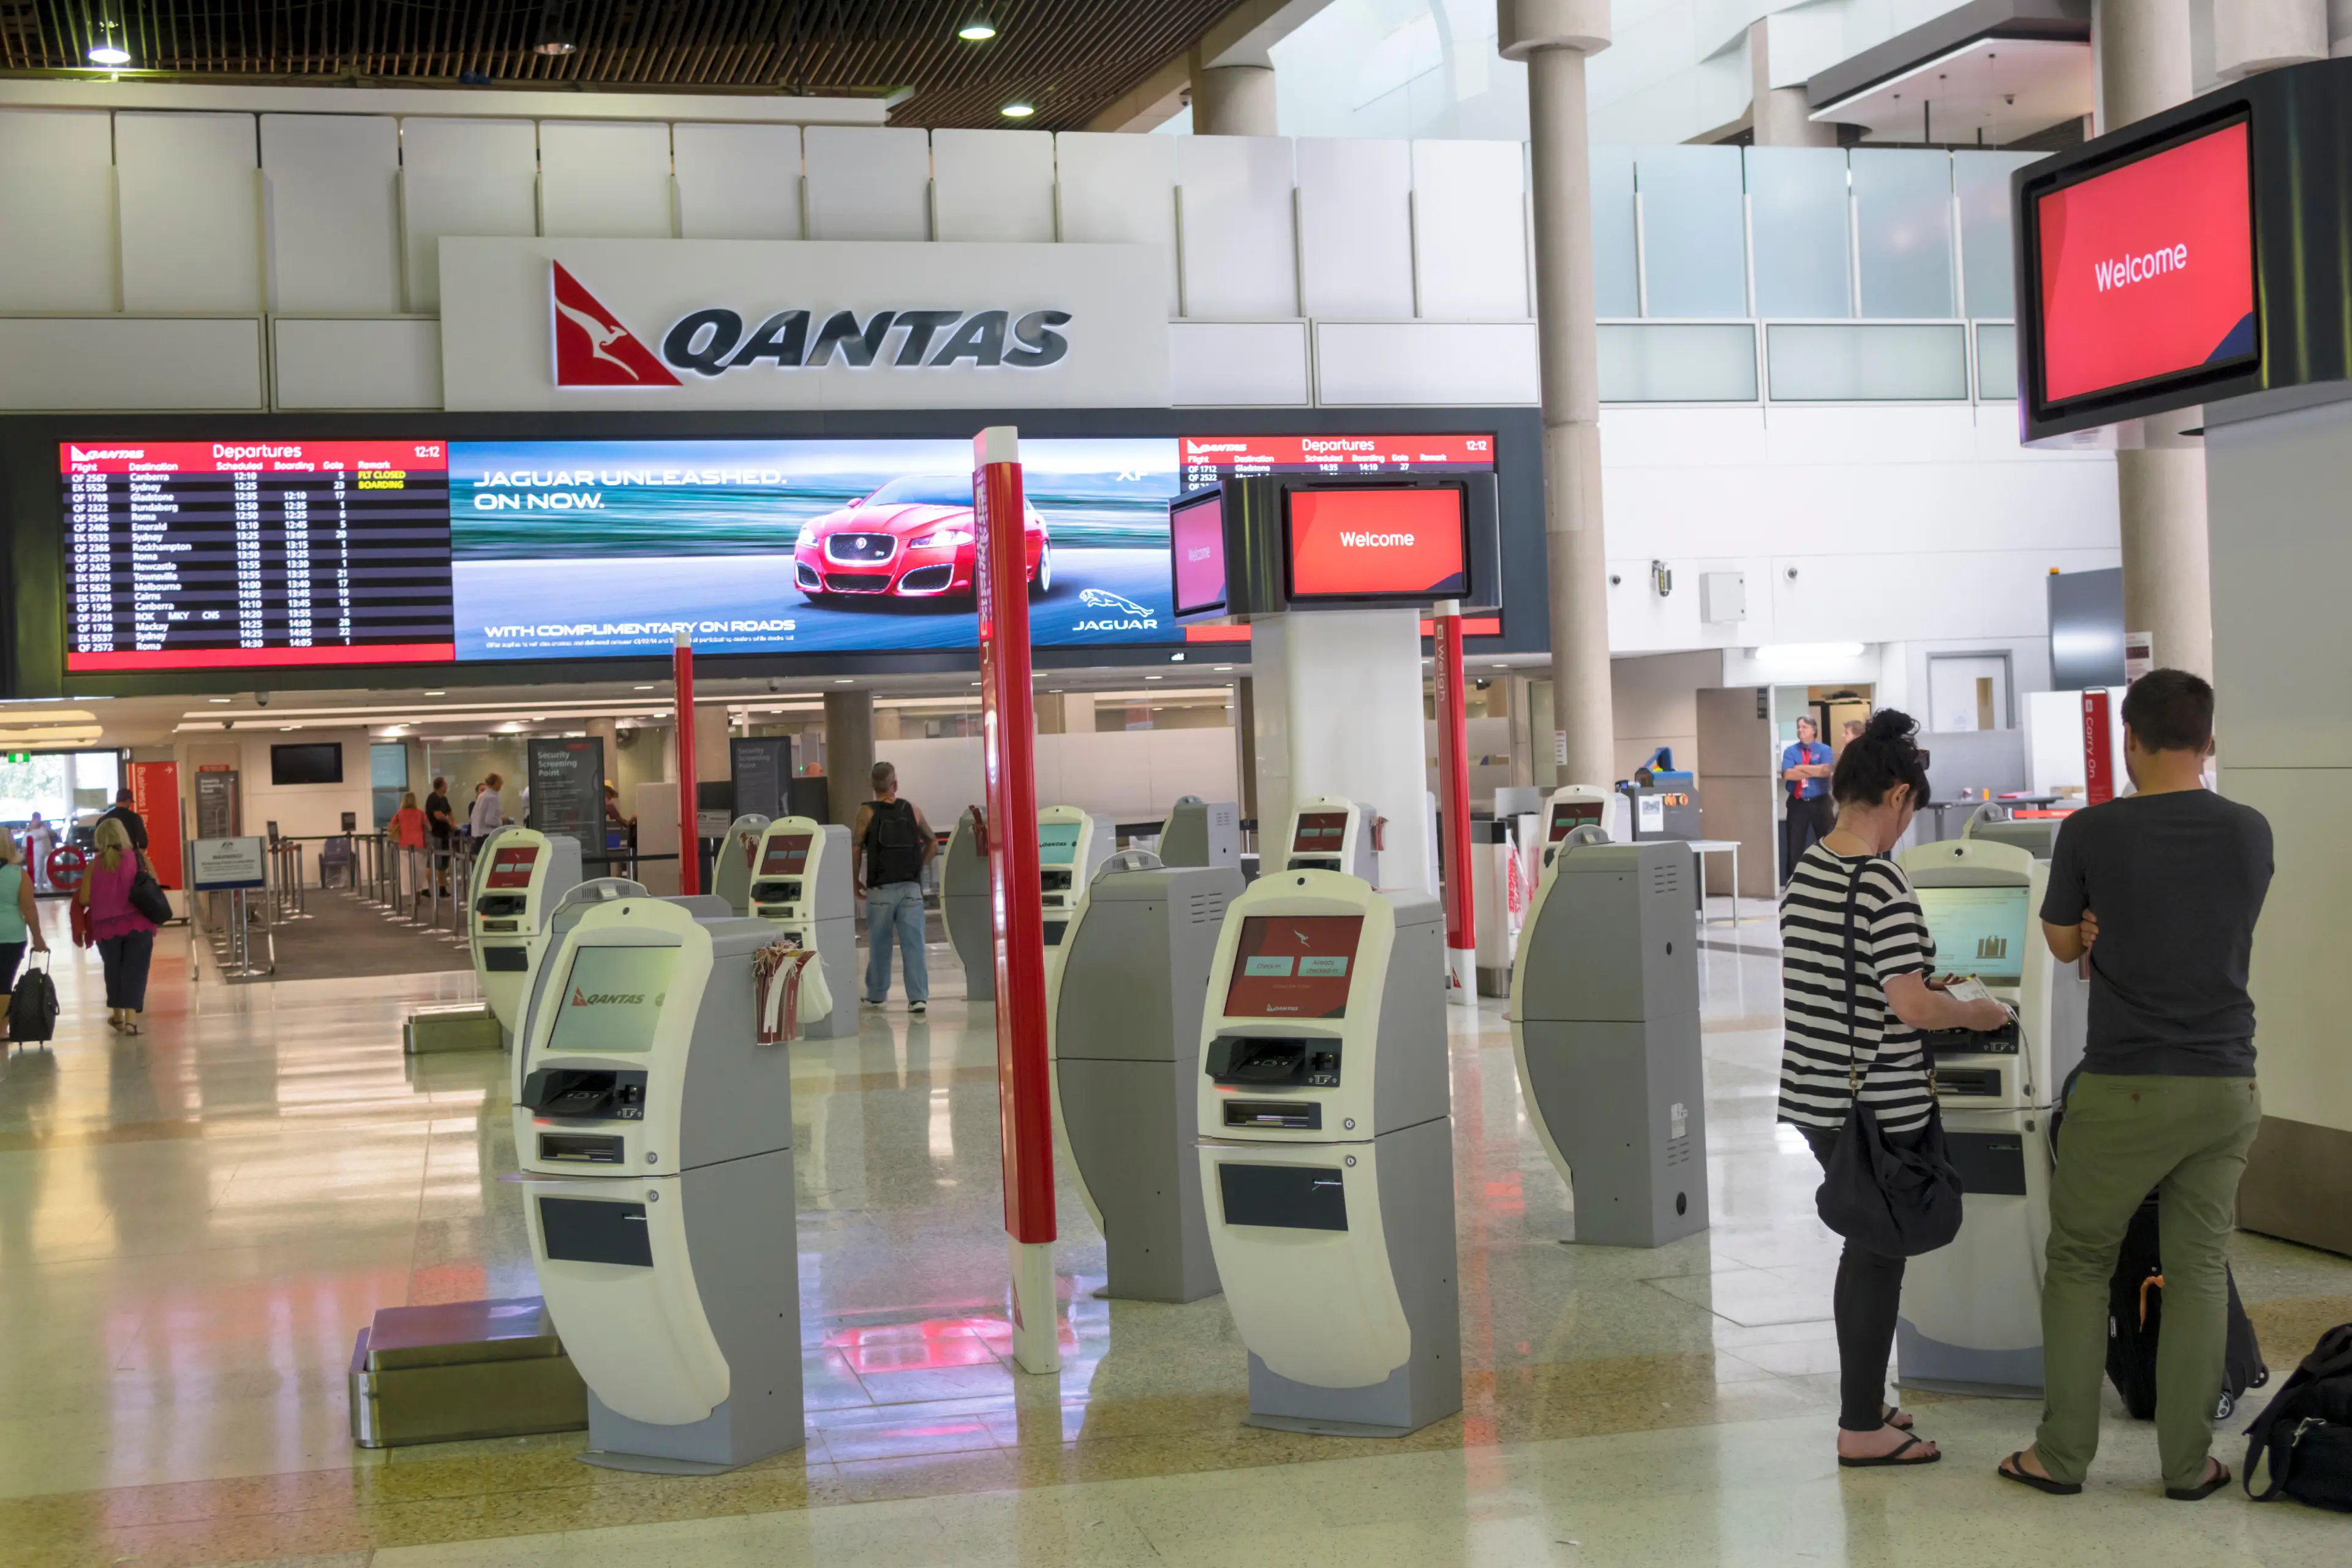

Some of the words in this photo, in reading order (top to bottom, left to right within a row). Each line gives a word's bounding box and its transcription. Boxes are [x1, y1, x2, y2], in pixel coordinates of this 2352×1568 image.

[2094, 242, 2188, 293] Welcome
[663, 306, 1074, 376] QANTAS
[86, 450, 145, 460] QANTAS
[212, 444, 303, 461] Departures
[414, 446, 440, 458] 12:12
[1200, 443, 1248, 453] QANTAS
[1302, 439, 1375, 453] Departures
[1466, 440, 1487, 451] 12:12
[1188, 456, 1209, 464] Flight
[1305, 454, 1343, 462] Scheduled
[1352, 454, 1385, 464] Boarding
[71, 462, 98, 473] Flight
[128, 462, 178, 471] Destination
[216, 461, 263, 470] Scheduled
[274, 461, 315, 472] Boarding
[323, 461, 344, 470] Gate
[358, 461, 391, 469] Remark
[72, 473, 85, 483] QF
[129, 472, 170, 481] Canberra
[234, 472, 257, 480] 12:10
[358, 470, 371, 479] FLT
[373, 470, 406, 479] CLOSED
[473, 470, 595, 487] JAGUAR
[601, 469, 787, 486] UNLEASHED.
[1115, 469, 1148, 481] XF
[72, 483, 85, 492] EK
[86, 483, 107, 492] 5529
[130, 483, 161, 493] Sydney
[235, 481, 257, 491] 12:25
[334, 481, 345, 489] 23
[358, 480, 404, 489] BOARDING
[72, 493, 86, 503] QF
[130, 493, 175, 502] Gladstone
[235, 492, 258, 500] 12:35
[284, 491, 307, 500] 12:10
[334, 491, 345, 499] 17
[473, 493, 520, 510] ON
[527, 492, 605, 510] NOW.
[73, 503, 86, 513] QF
[87, 503, 108, 513] 2322
[131, 503, 178, 513] Bundaberg
[235, 502, 258, 511] 12:50
[284, 501, 307, 510] 12:35
[73, 514, 86, 523] QF
[131, 513, 157, 521] Roma
[235, 511, 259, 520] 12:50
[284, 510, 307, 519] 12:25
[339, 510, 347, 518] 6
[74, 523, 86, 532] QF
[132, 522, 167, 531] Emerald
[236, 521, 259, 530] 13:10
[285, 521, 307, 529] 12:45
[340, 520, 347, 529] 5
[74, 533, 86, 542] EK
[88, 533, 109, 542] 5533
[132, 533, 163, 543] Sydney
[236, 531, 259, 540] 13:25
[285, 530, 308, 540] 13:05
[336, 530, 347, 538] 20
[1340, 530, 1415, 548] Welcome
[74, 543, 87, 552] QF
[132, 543, 192, 552] Rockhampton
[236, 541, 260, 550] 13:40
[286, 540, 309, 549] 13:15
[75, 554, 88, 563] QF
[89, 554, 111, 563] 2570
[132, 552, 158, 561] Roma
[237, 551, 260, 559] 13:50
[286, 549, 309, 559] 13:25
[341, 549, 348, 557] 5
[75, 563, 88, 572] QF
[133, 562, 177, 571] Newcastle
[238, 560, 260, 569] 13:55
[287, 560, 309, 568] 13:30
[75, 573, 88, 582] EK
[133, 572, 178, 581] Townsville
[238, 570, 261, 579] 13:55
[287, 570, 310, 578] 13:35
[337, 569, 347, 578] 21
[76, 583, 88, 592] EK
[134, 582, 182, 591] Melbourne
[238, 581, 261, 589] 14:00
[287, 579, 310, 589] 13:40
[76, 594, 89, 603] EK
[134, 592, 161, 601] Cairns
[238, 590, 262, 598] 14:05
[287, 589, 311, 598] 13:45
[338, 588, 349, 597] 19
[77, 603, 89, 612] QF
[134, 602, 175, 611] Canberra
[239, 600, 262, 608] 14:10
[288, 599, 311, 608] 13:45
[339, 598, 350, 606] 16
[77, 613, 90, 623] QF
[239, 610, 263, 619] 14:20
[288, 609, 311, 618] 13:55
[343, 608, 350, 617] 5
[77, 624, 90, 633] QF
[135, 622, 169, 632] Mackay
[239, 620, 263, 628] 14:25
[288, 619, 312, 627] 14:00
[484, 625, 535, 638] WITH
[537, 621, 698, 636] COMPLIMENTARY
[699, 620, 728, 633] ON
[731, 619, 796, 631] ROADS
[1072, 619, 1157, 631] JAGUAR
[78, 633, 91, 643] EK
[91, 633, 113, 643] 5537
[135, 632, 167, 642] Sydney
[240, 629, 263, 638] 14:25
[289, 628, 312, 636] 14:05
[339, 627, 350, 636] 22
[78, 643, 91, 652] QF
[92, 643, 113, 652] 2572
[136, 642, 161, 650] Roma
[240, 639, 263, 648] 14:30
[289, 638, 312, 647] 14:05
[2085, 717, 2094, 755] Carry
[538, 751, 570, 760] Security
[2088, 758, 2096, 778] On
[137, 766, 146, 807] Business
[587, 993, 645, 1005] QANTAS
